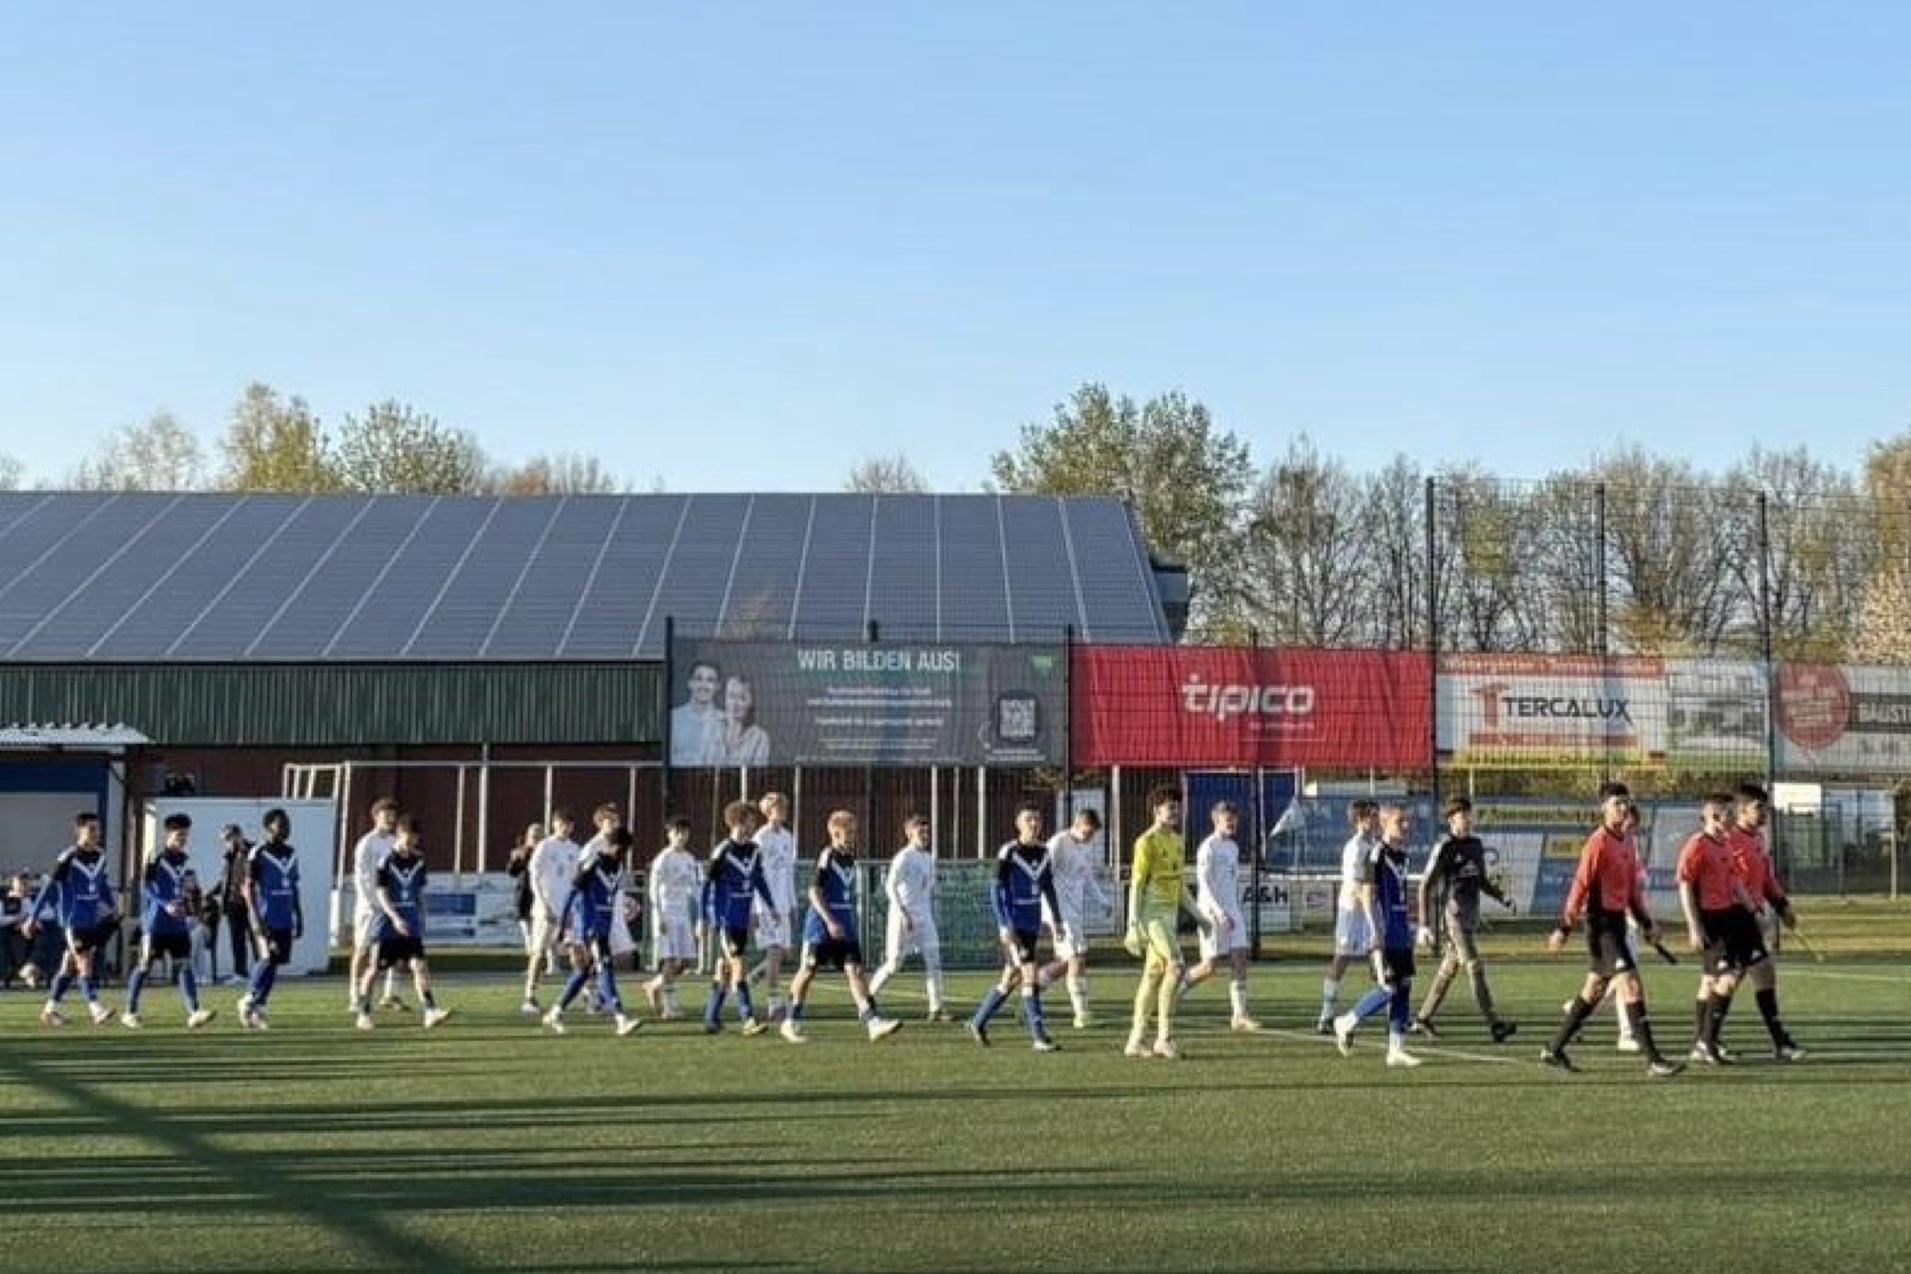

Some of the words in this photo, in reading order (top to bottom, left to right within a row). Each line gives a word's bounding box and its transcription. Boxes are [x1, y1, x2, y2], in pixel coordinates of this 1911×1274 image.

[797, 649, 836, 672] WIR
[843, 649, 911, 672] BILDEN
[1181, 672, 1316, 722] tipico
[1501, 697, 1634, 726] TERCALUX
